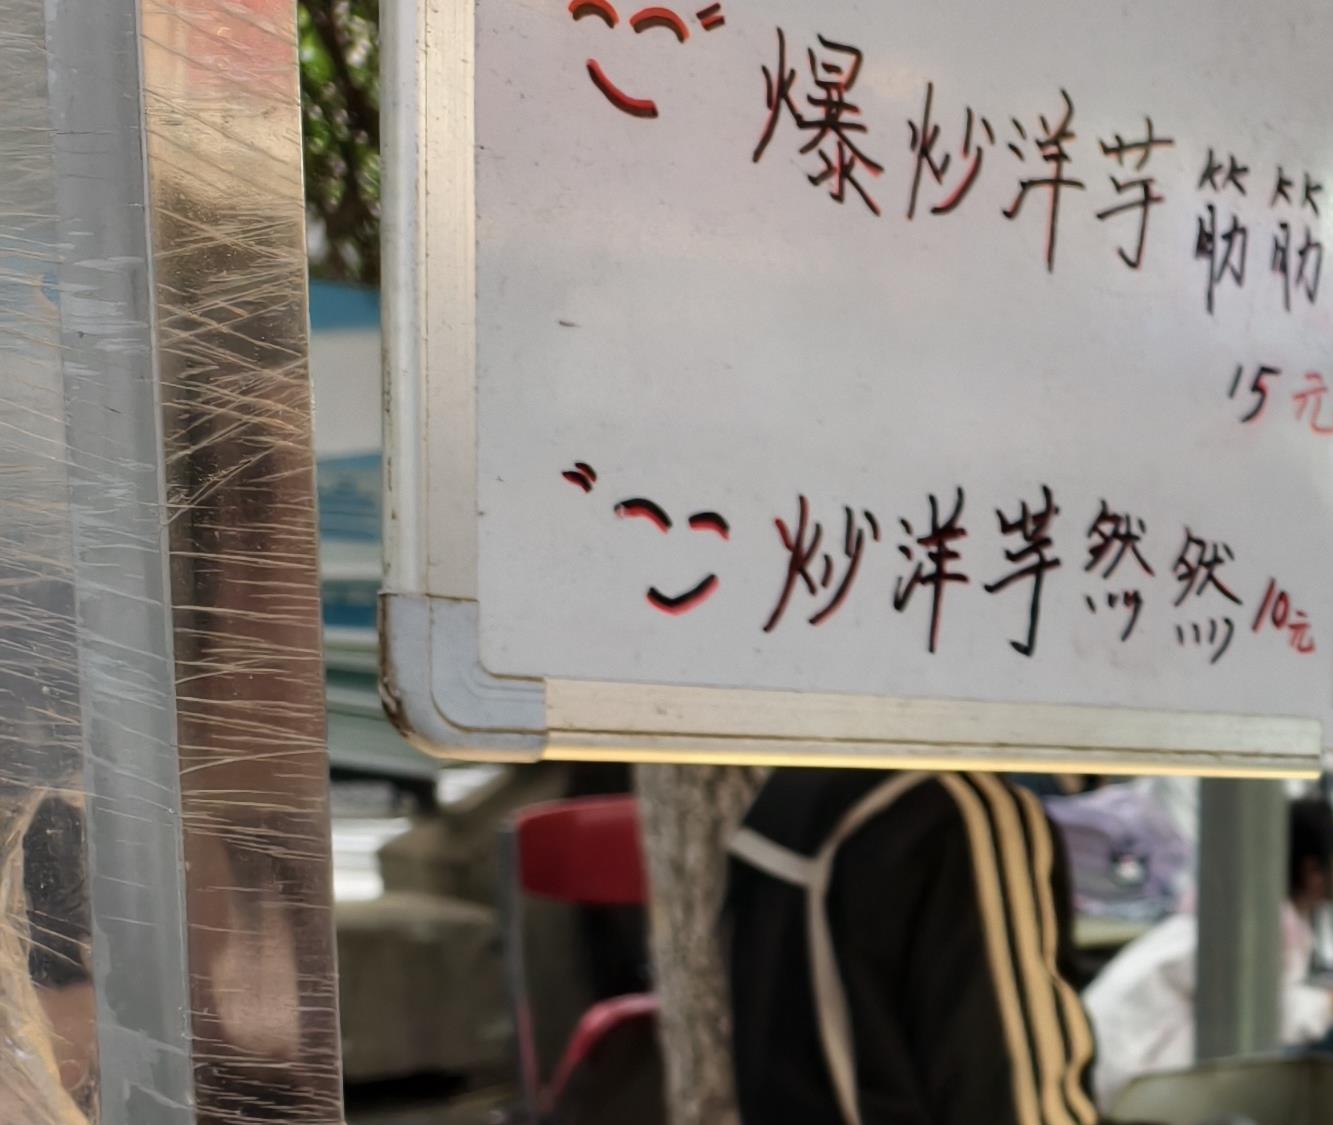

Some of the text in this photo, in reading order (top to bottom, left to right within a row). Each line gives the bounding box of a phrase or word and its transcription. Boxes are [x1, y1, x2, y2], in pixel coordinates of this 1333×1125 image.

[753, 27, 1324, 314] 爆炒洋芋筋筋
[763, 484, 1244, 663] 炒洋芋然然
